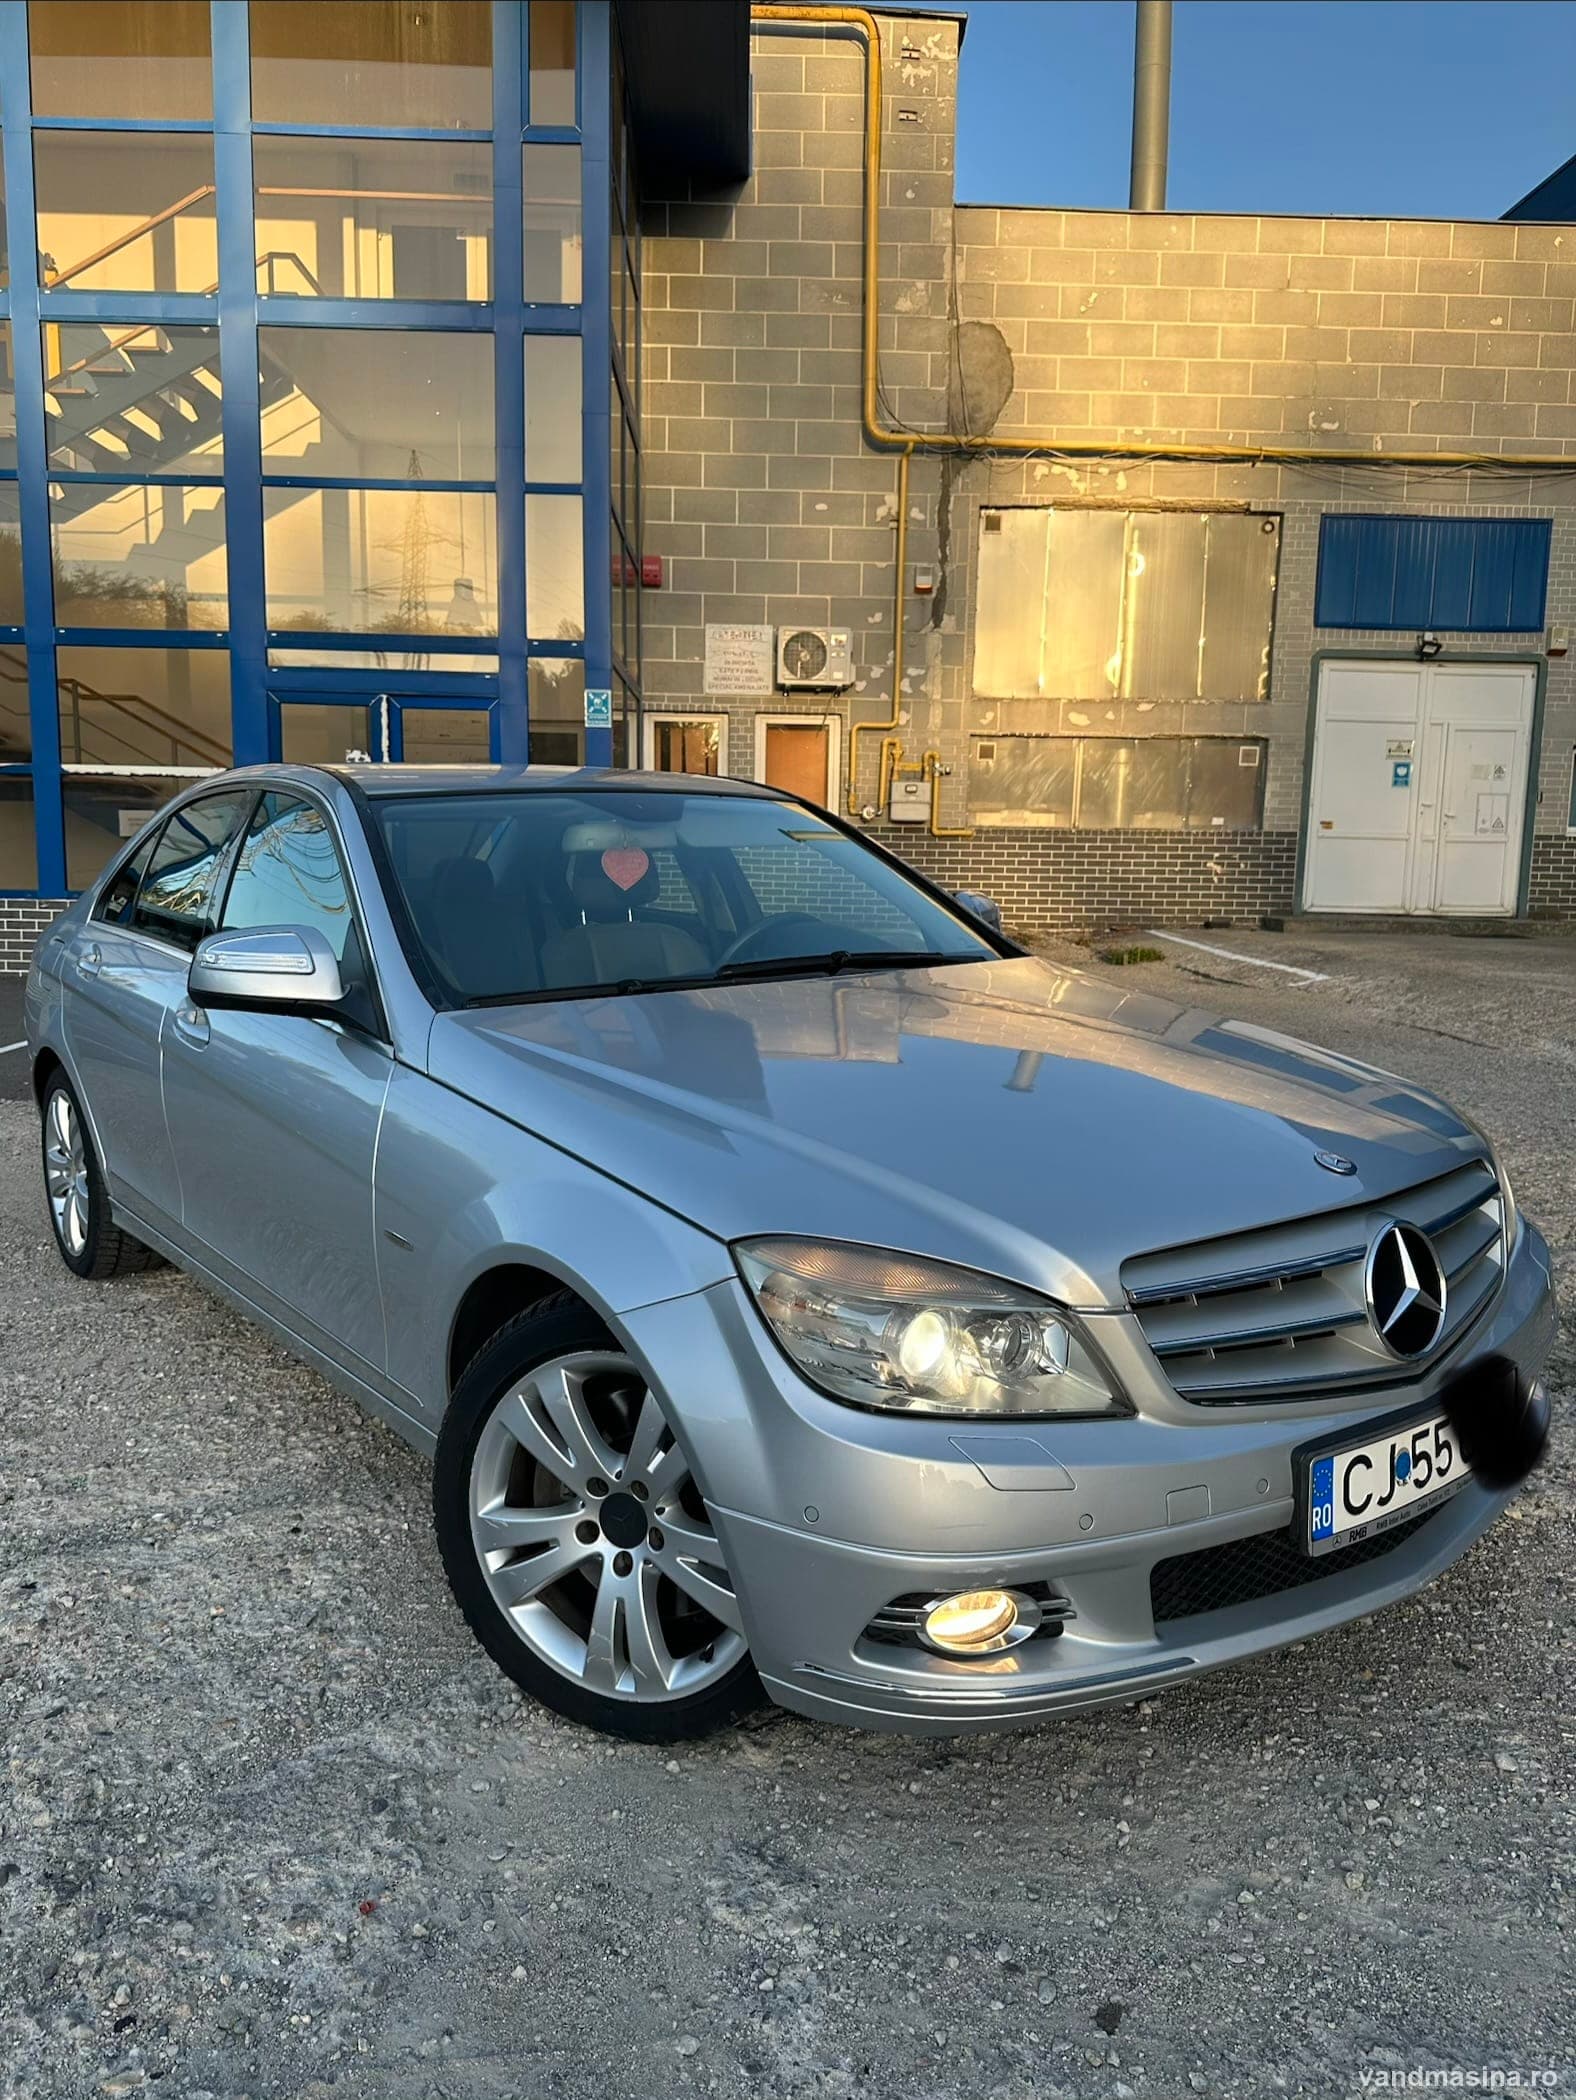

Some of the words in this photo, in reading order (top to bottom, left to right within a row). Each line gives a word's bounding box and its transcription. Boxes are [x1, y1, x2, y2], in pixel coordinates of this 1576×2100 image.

[1343, 1443, 1396, 1516] CJ
[1412, 1418, 1452, 1489] 55
[1312, 1503, 1332, 1532] RO
[1348, 1526, 1367, 1543] RMB
